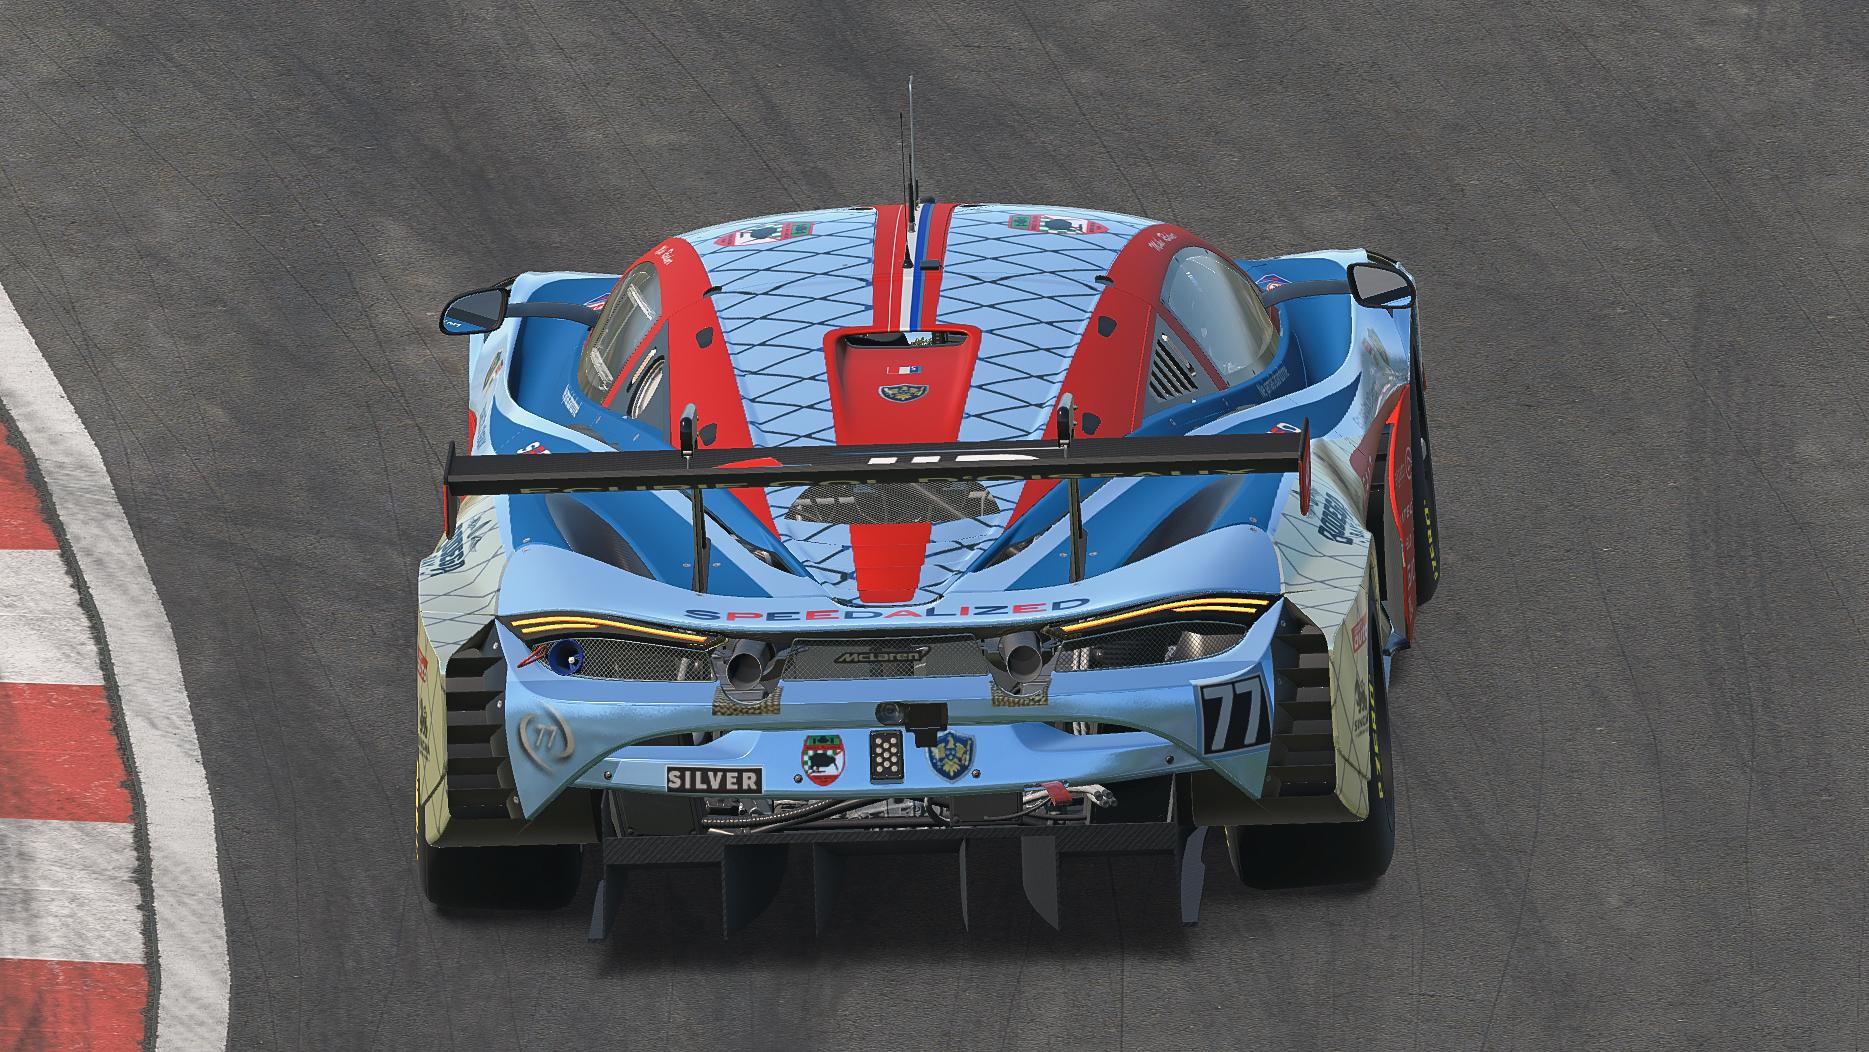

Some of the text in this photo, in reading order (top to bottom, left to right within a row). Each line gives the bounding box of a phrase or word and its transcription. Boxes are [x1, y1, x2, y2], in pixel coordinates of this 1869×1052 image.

[684, 597, 1091, 622] SPEEDALIZED
[837, 650, 922, 663] McLaren
[1203, 677, 1262, 752] 77
[535, 723, 558, 750] 77
[667, 770, 758, 791] SILVER
